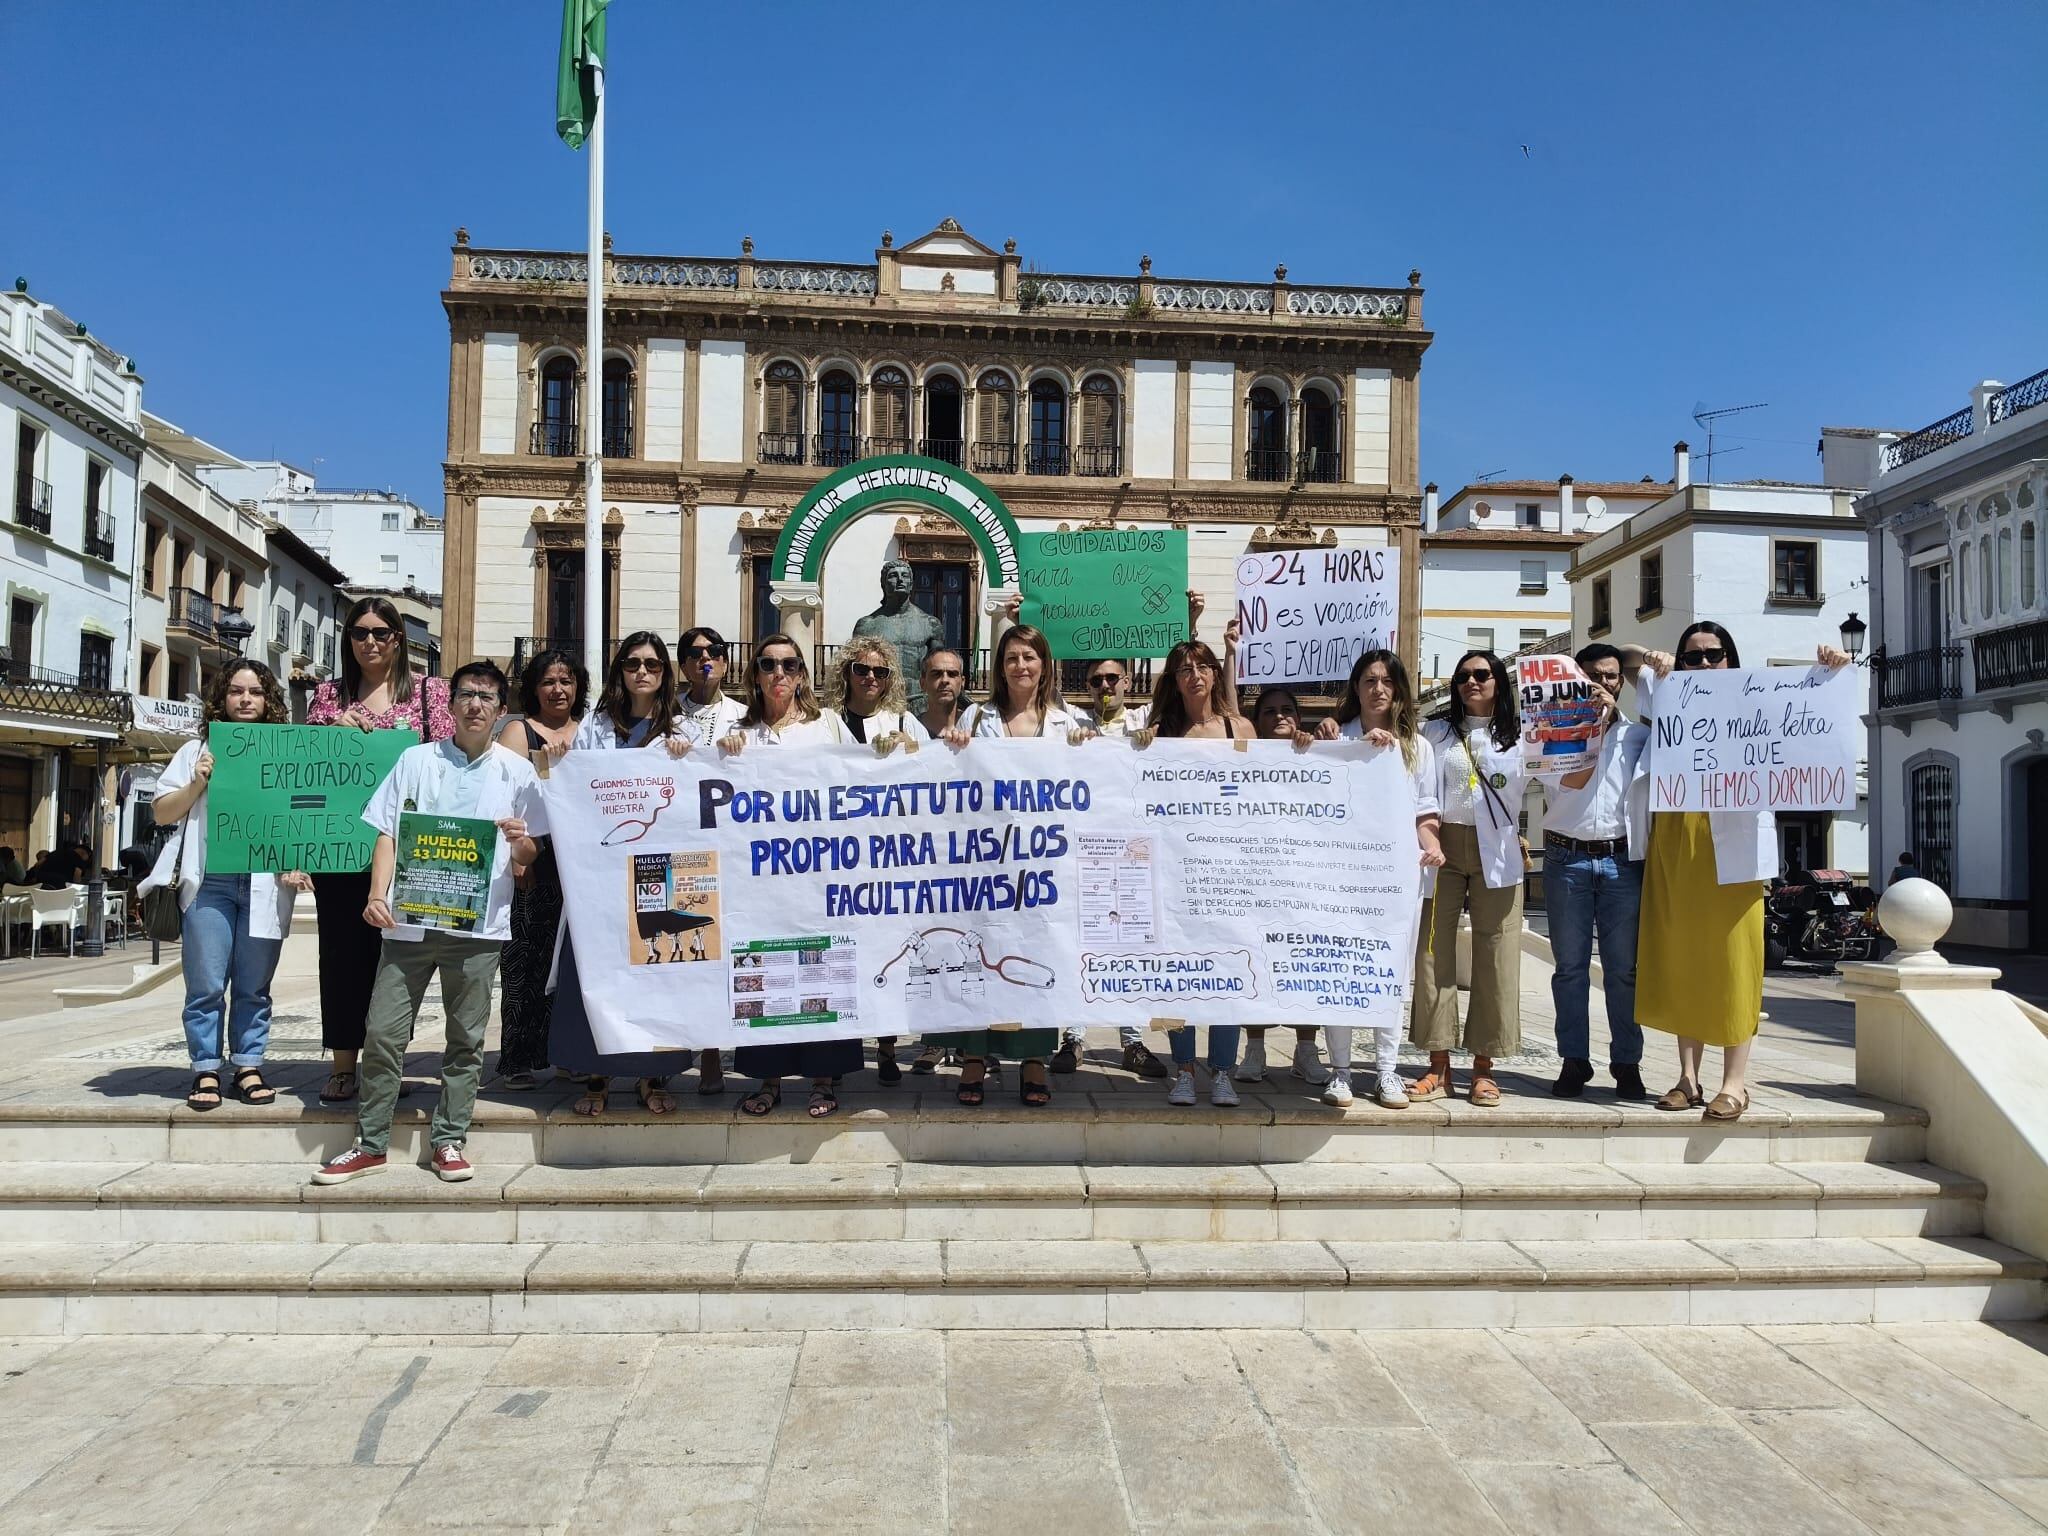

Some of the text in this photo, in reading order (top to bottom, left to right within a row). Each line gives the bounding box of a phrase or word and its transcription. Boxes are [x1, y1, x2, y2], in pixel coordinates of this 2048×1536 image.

[784, 466, 1020, 586] DOMINATOR HERCULES FUNDATOR
[1264, 550, 1384, 586] 24 HORAS
[1024, 567, 1073, 592] para
[1040, 595, 1110, 626] podamos
[1238, 596, 1267, 635] NO
[1276, 608, 1303, 627] es
[1521, 681, 1594, 704] 13 JUNI
[154, 702, 190, 717] ASADOR
[1657, 700, 1834, 748] NO es mala letra
[226, 727, 365, 758] SANITARIOS
[1694, 741, 1785, 771] ES QUE
[261, 761, 377, 789] EXPLOTADOS
[634, 778, 645, 786] TU
[646, 776, 674, 787] SALUD
[1142, 766, 1331, 784] MÉDICOS/AS EXPLOTADOS
[1657, 766, 1845, 808] NO HEMOS DORMIDO
[595, 794, 600, 802] A
[600, 792, 627, 802] COSTA
[640, 791, 649, 799] LA
[698, 779, 1091, 829] POR UN ESTATUTO MARCO
[602, 803, 645, 815] NUESTRA
[1146, 802, 1346, 819] PACIENTES MALTRATADOS
[217, 813, 355, 841] PACIENTES
[417, 834, 477, 849] HUELGA
[1186, 833, 1219, 844] CUANDO
[1219, 836, 1259, 845] ESCUCHES
[1279, 834, 1313, 847] MÉDICOS
[1313, 840, 1330, 848] SON
[248, 842, 372, 871] MALTRATAD
[413, 849, 478, 862] 13 JUNIO
[750, 824, 1068, 876] PROPIO PARA LAS/LOS
[1240, 846, 1297, 855] RECUERDA QUE
[635, 856, 667, 864] HUELGA
[1276, 859, 1291, 867] QUE
[1347, 863, 1359, 871] EN
[1360, 864, 1395, 873] SANIDAD
[826, 869, 1058, 916] FACULTATIVAS/OS
[1186, 886, 1197, 894] DE
[1212, 887, 1256, 896] PERSONAL
[1205, 898, 1253, 908] DERECHOS
[1255, 899, 1272, 908] NOS
[1350, 907, 1385, 916] PRIVADO
[1216, 908, 1246, 917] SALUD
[1266, 932, 1391, 951] NO ES UNA PROTESTA
[1290, 948, 1374, 963] CORPORATIVA
[1110, 959, 1137, 973] POR
[1138, 959, 1161, 973] TU
[1166, 959, 1214, 973] SALUD
[1273, 961, 1394, 978] ES UN GRITO POR LA
[1088, 977, 1244, 993] Y NUESTRA DIGNIDAD
[1276, 979, 1331, 993] SANIDAD
[1333, 977, 1381, 995] PÚBLICA
[1384, 983, 1392, 995] Y
[1317, 995, 1370, 1008] CALIDAD
